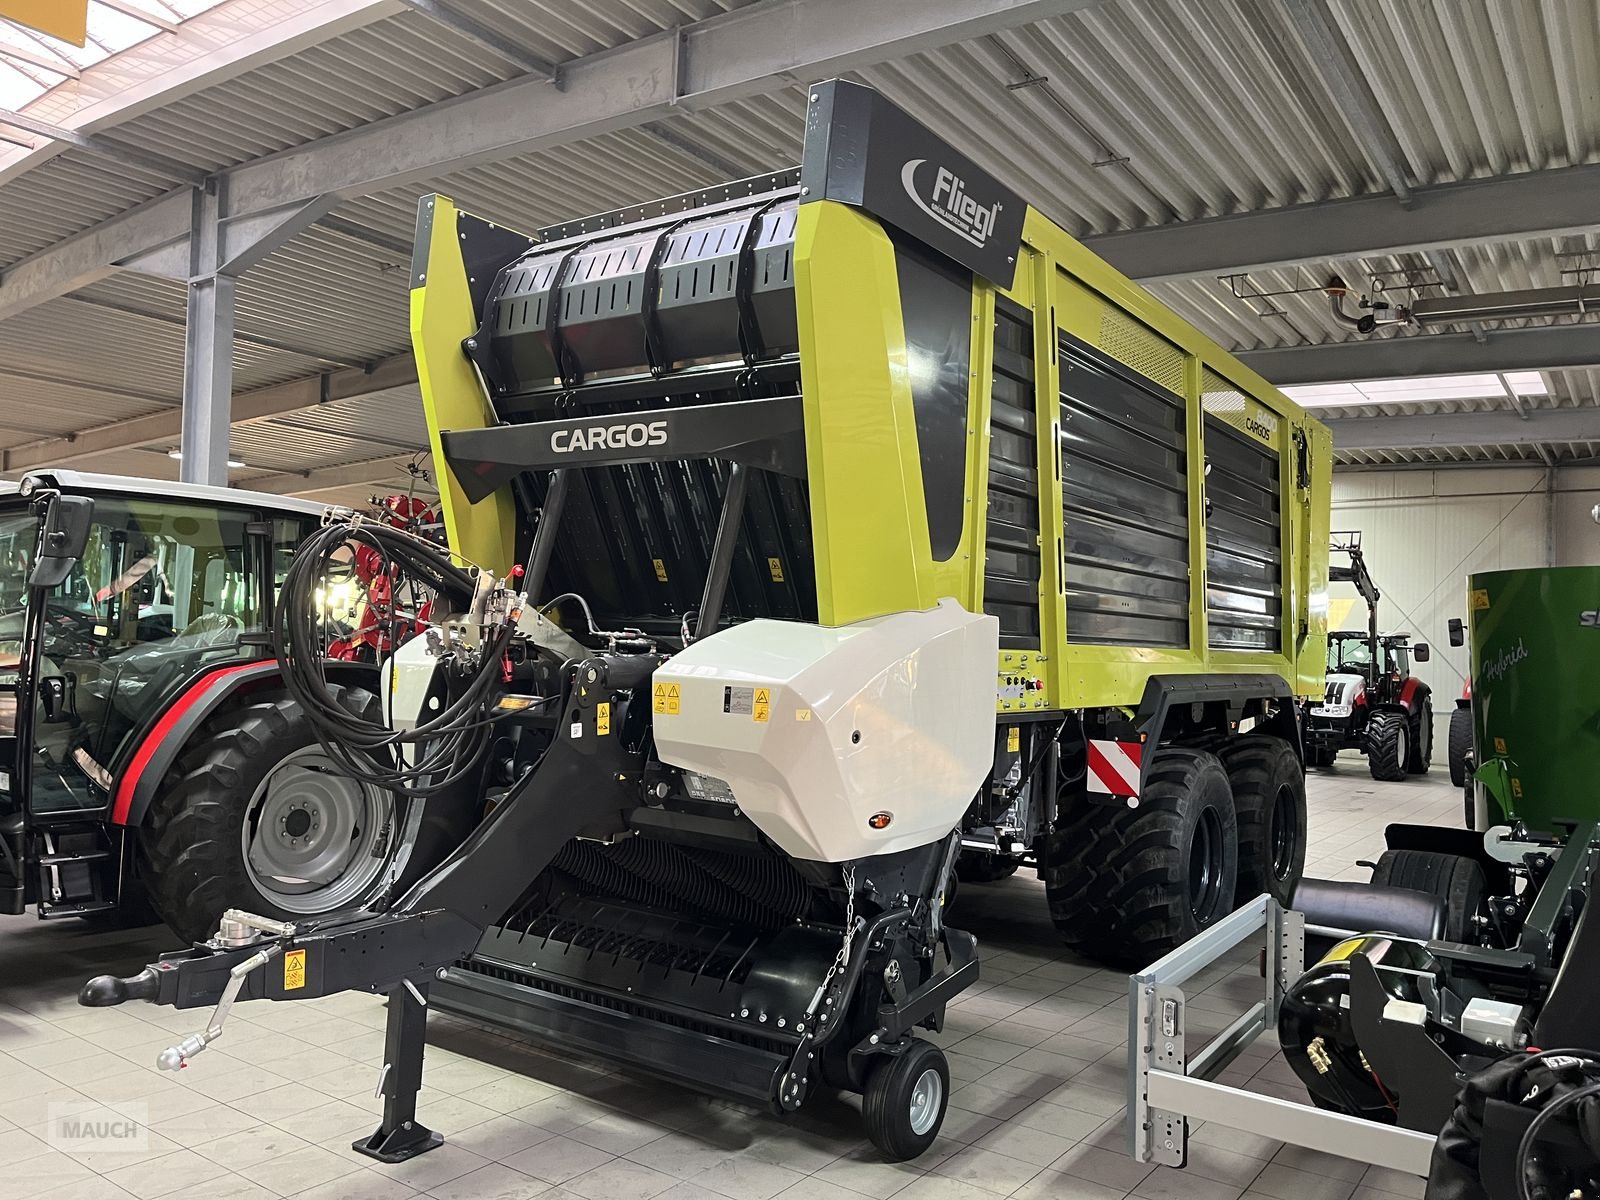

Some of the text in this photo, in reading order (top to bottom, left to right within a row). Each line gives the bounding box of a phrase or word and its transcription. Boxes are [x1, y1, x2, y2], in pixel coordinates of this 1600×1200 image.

[932, 166, 998, 242] Fliegl
[550, 421, 668, 453] CARGOS
[1246, 418, 1271, 440] CARGOS
[1482, 637, 1528, 681] Hybrid
